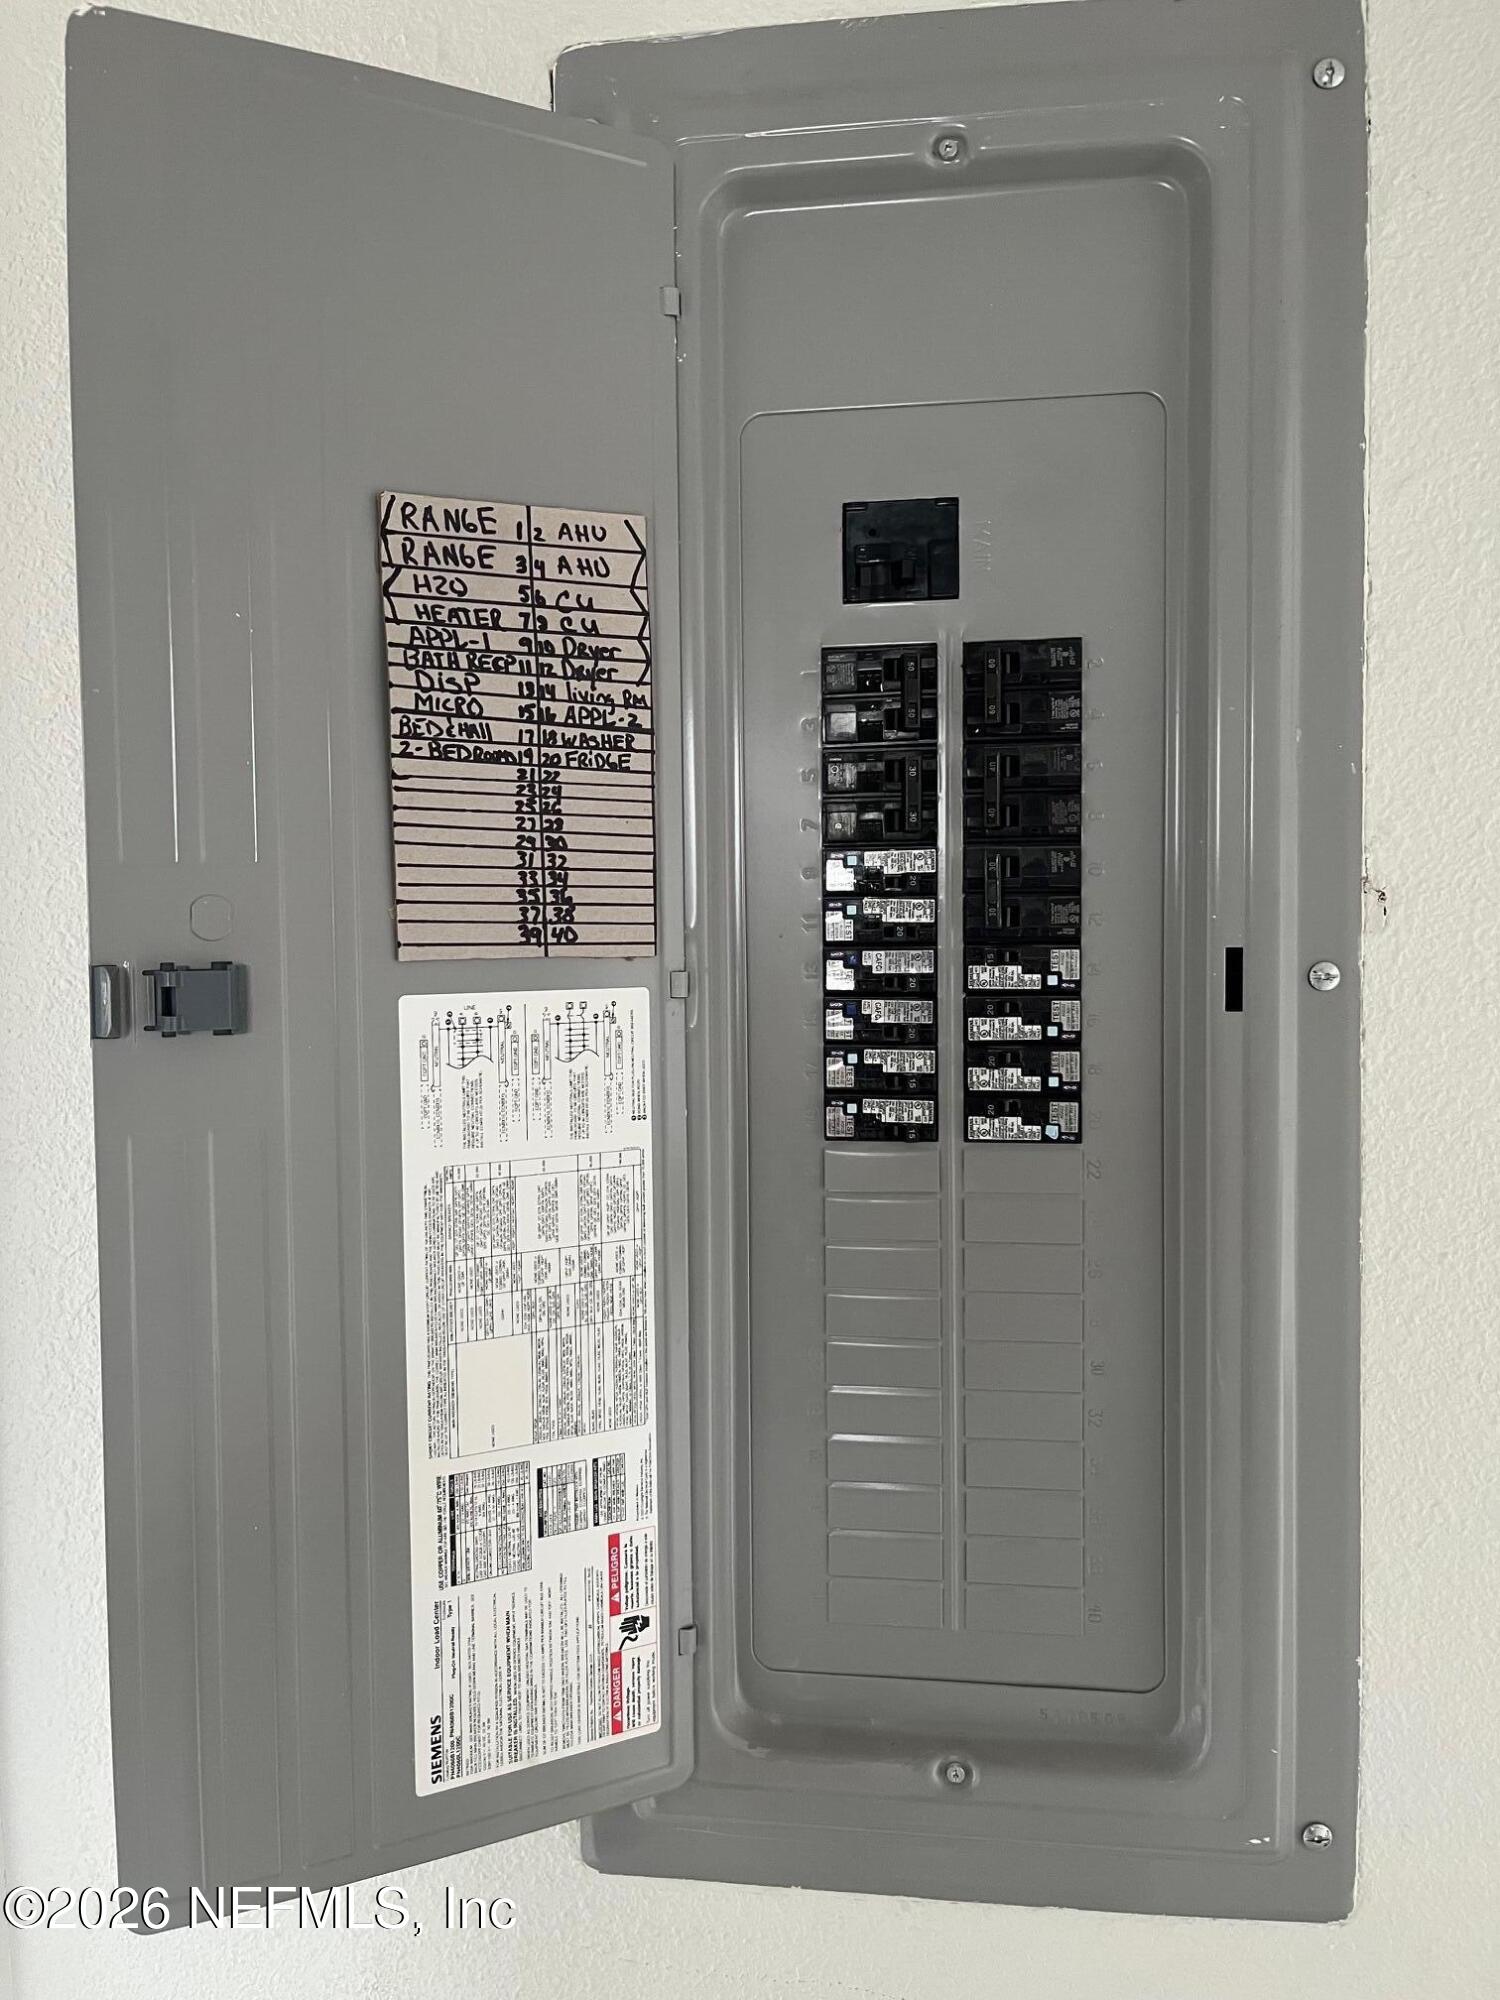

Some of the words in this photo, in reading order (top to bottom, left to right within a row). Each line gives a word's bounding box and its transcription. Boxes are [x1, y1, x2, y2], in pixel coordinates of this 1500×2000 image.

[401, 501, 497, 535] RANGE
[516, 521, 523, 541] 1
[533, 527, 546, 542] 2
[558, 522, 607, 543] AHU
[401, 537, 497, 569] RANGE
[515, 555, 528, 574] 3
[534, 559, 546, 579] 4
[557, 555, 611, 578] AHU
[518, 584, 531, 603] 5
[534, 589, 546, 606] 6
[414, 603, 502, 627] HEATER
[518, 611, 531, 630] 7
[409, 626, 491, 651] APPL-1
[518, 637, 532, 656] 9
[537, 638, 555, 655] 10
[403, 649, 461, 671] BATH
[518, 659, 532, 675] 11
[539, 662, 557, 677] 12
[518, 681, 535, 698] 13
[540, 683, 556, 700] 14
[414, 692, 484, 719] MICRO
[518, 703, 536, 720] 15
[565, 705, 642, 728] APPL-2
[518, 729, 535, 744] 17
[542, 729, 558, 745] 18
[561, 732, 637, 751] WASHER
[518, 747, 533, 765] 19
[541, 752, 562, 768] 20
[516, 767, 535, 782] 21
[542, 769, 561, 783] 22
[909, 766, 917, 777] 30
[515, 816, 536, 831] 27
[799, 817, 819, 832] 7
[909, 811, 917, 823] 30
[515, 834, 537, 851] 29
[515, 850, 534, 868] 31
[546, 852, 568, 869] 32
[517, 870, 539, 886] 33
[909, 875, 917, 886] 20
[515, 888, 540, 904] 35
[518, 905, 541, 925] 37
[517, 924, 542, 948] 39
[551, 925, 579, 944] 40
[896, 926, 904, 937] 20
[909, 977, 917, 988] 20
[987, 1004, 994, 1015] 20
[1052, 1001, 1060, 1021] TEST
[909, 1027, 916, 1039] 20
[988, 1056, 996, 1067] 20
[846, 1067, 854, 1088] TEST
[909, 1077, 916, 1088] 15
[987, 1104, 994, 1115] 20
[846, 1117, 854, 1136] TEST
[909, 1128, 916, 1139] 15
[1086, 1160, 1103, 1180] 22
[1089, 1360, 1105, 1376] 30
[1087, 1408, 1104, 1428] 32
[611, 1547, 619, 1589] PELIGRO
[613, 1667, 621, 1708] DANGER
[430, 1715, 442, 1784] SIEMENS
